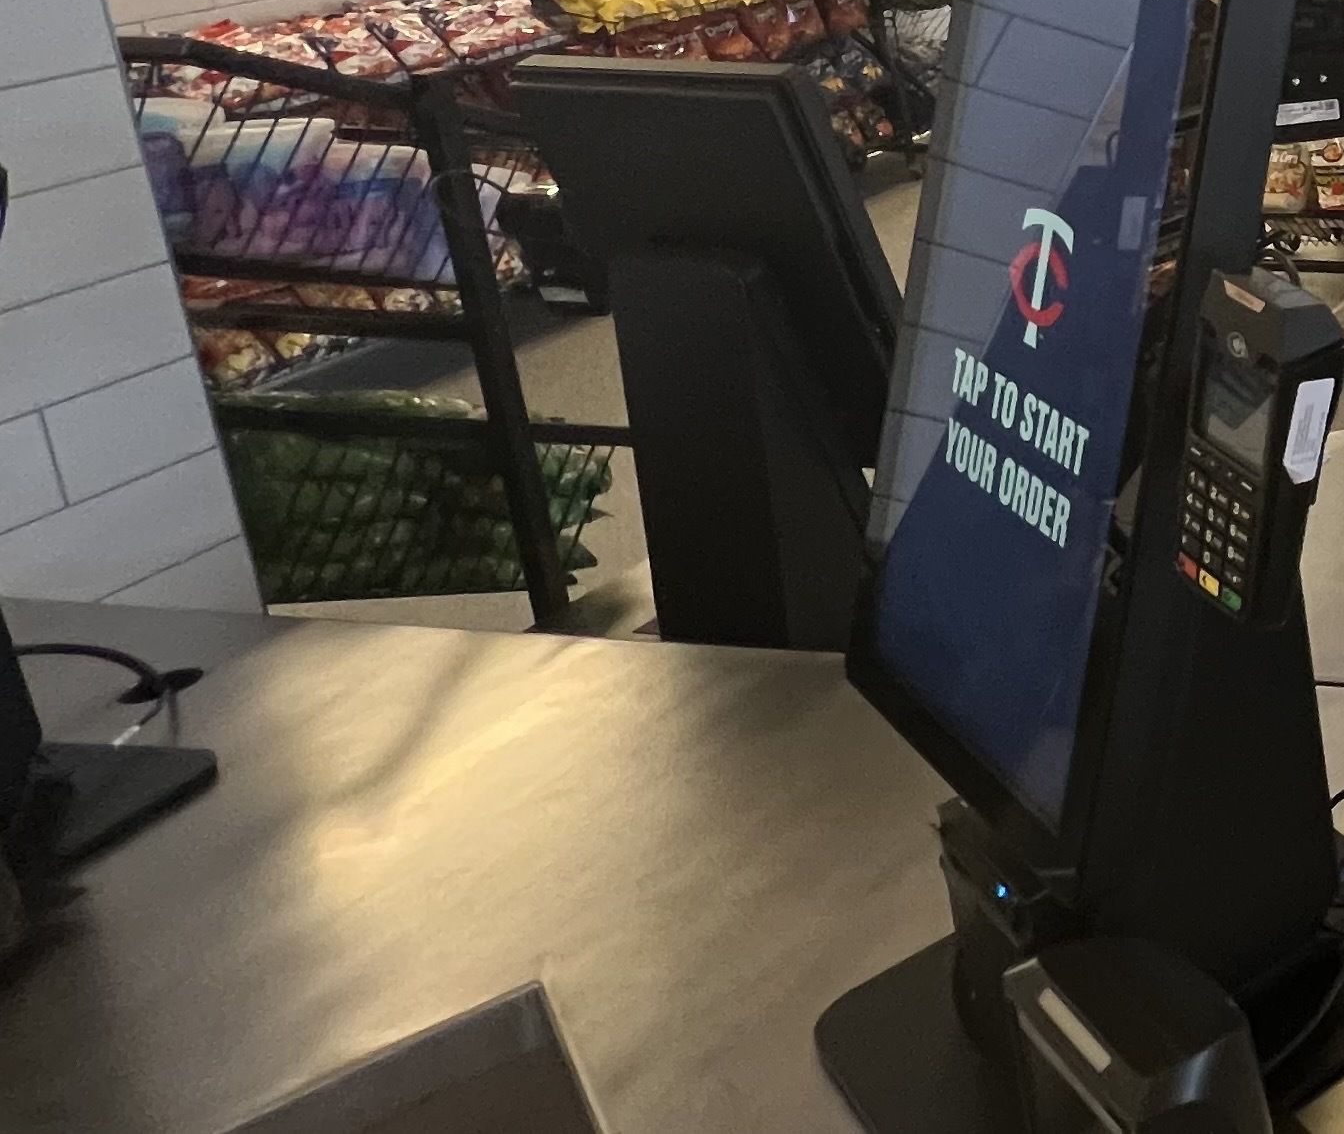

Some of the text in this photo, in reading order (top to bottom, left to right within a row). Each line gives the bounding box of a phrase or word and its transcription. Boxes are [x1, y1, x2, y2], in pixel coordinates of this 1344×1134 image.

[952, 347, 1090, 476] TAP TO START
[945, 417, 1071, 548] YOUR ORDER
